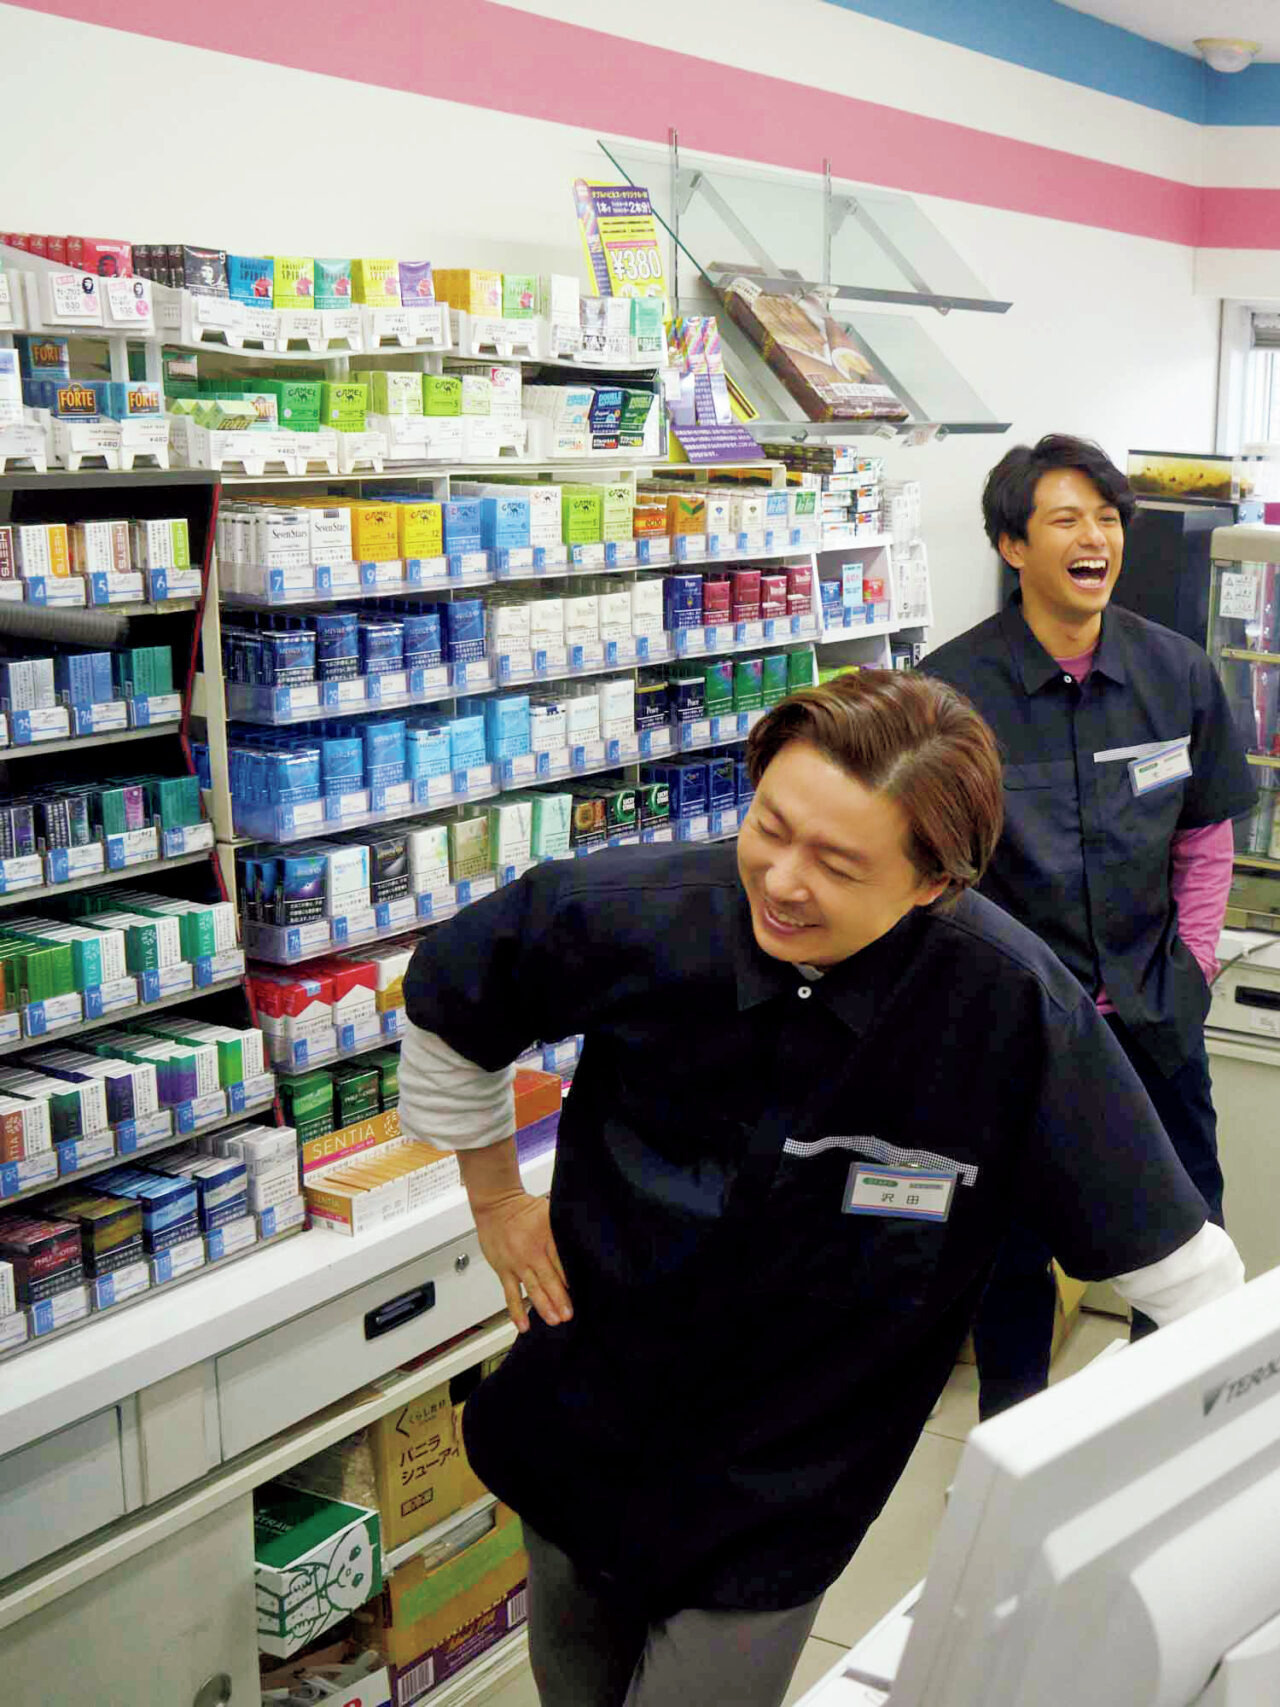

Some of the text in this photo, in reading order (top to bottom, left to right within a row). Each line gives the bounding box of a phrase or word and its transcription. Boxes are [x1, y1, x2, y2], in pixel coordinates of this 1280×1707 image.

[611, 249, 661, 280] ¥380
[59, 391, 95, 408] FORTE
[129, 391, 159, 408] FORTE
[53, 529, 65, 573] HEETS
[115, 525, 129, 569] HEETS
[35, 585, 44, 598] 4
[156, 576, 165, 589] 6
[312, 1124, 376, 1160] SENTIA
[881, 1193, 920, 1205] 沢田
[400, 1433, 441, 1467] バニラ
[401, 1442, 460, 1486] シューアイ
